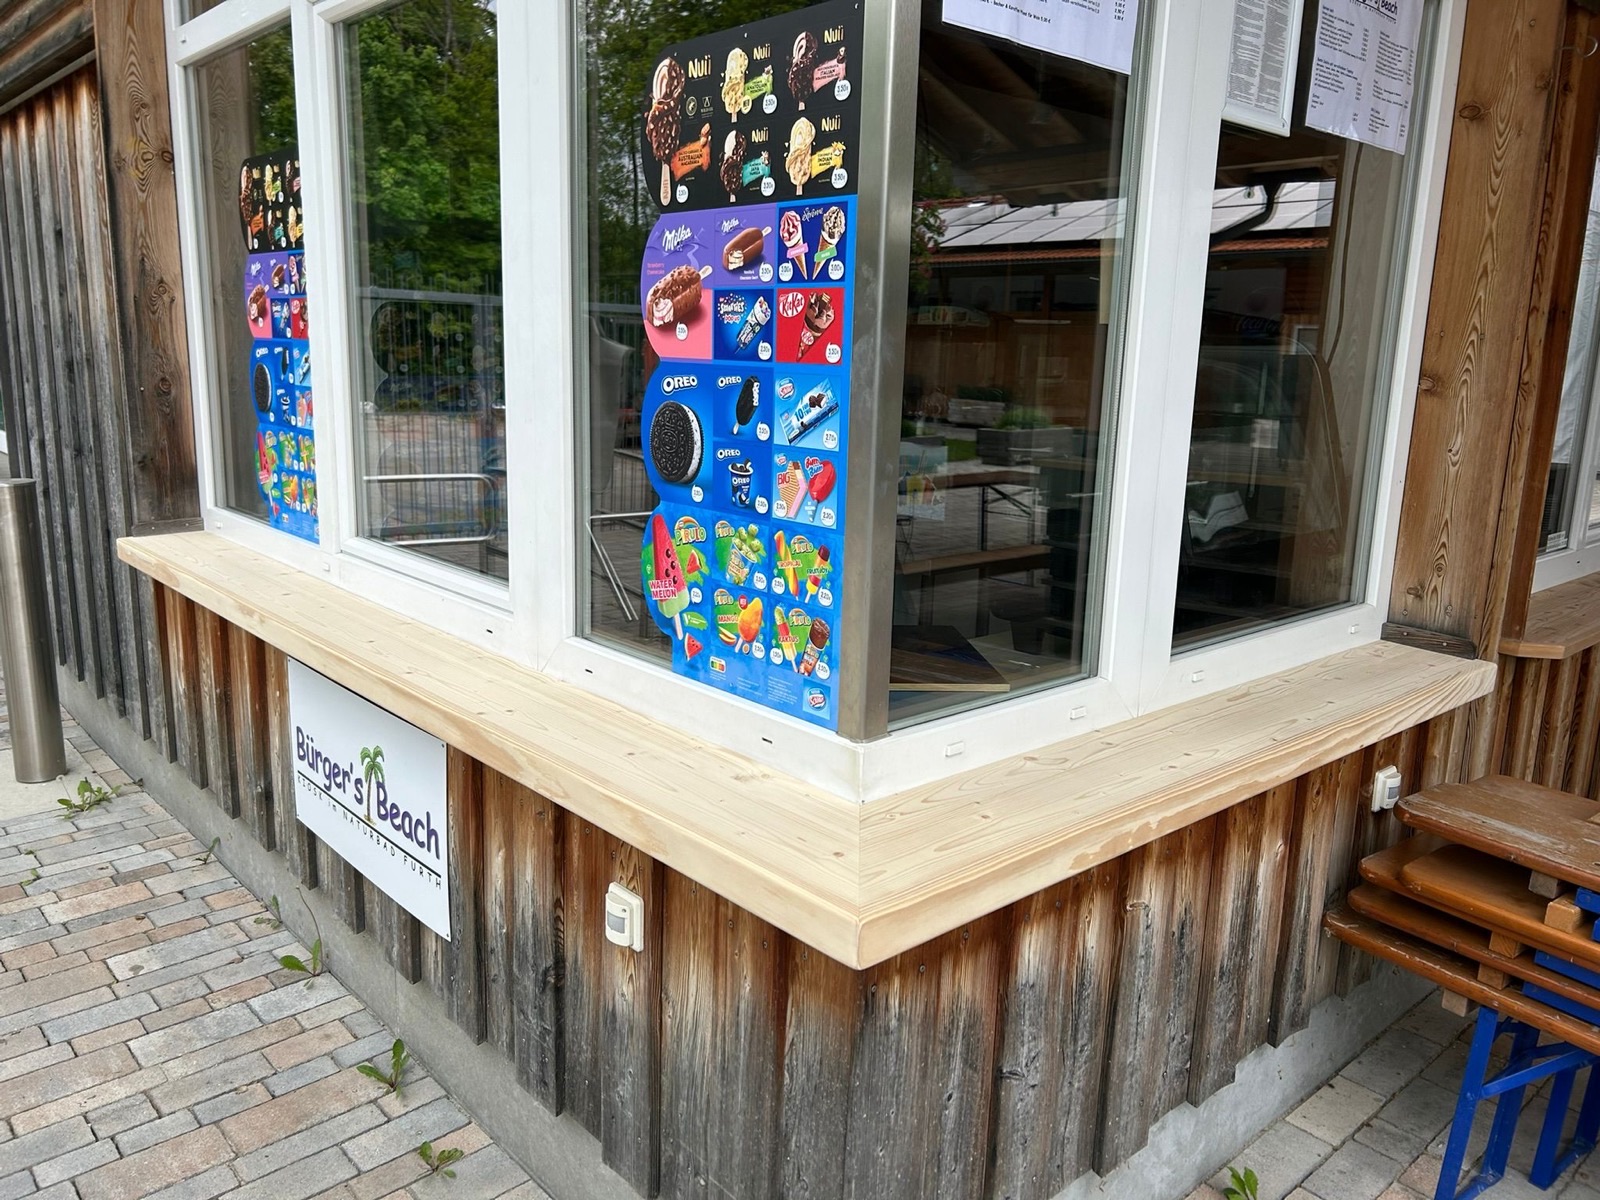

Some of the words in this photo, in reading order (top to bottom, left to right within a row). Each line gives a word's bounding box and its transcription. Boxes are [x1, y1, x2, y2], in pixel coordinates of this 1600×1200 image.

[721, 217, 740, 233] Milka
[662, 225, 692, 252] Milka
[663, 376, 697, 392] OREO
[719, 376, 741, 387] OREO
[794, 409, 804, 421] 10
[717, 449, 741, 459] OREO
[732, 477, 750, 485] OREO
[777, 472, 791, 486] BIG
[675, 527, 706, 546] PIRULO
[649, 580, 673, 590] WATER
[652, 588, 677, 599] MELON
[718, 614, 739, 623] MANGO
[778, 635, 799, 643] KAKTUS
[296, 726, 364, 805] Bürger's
[376, 780, 441, 860] Beach
[297, 774, 324, 802] KIOSK
[328, 800, 337, 812] im
[342, 811, 396, 857] NATURBAD
[403, 854, 442, 890] FURTH
